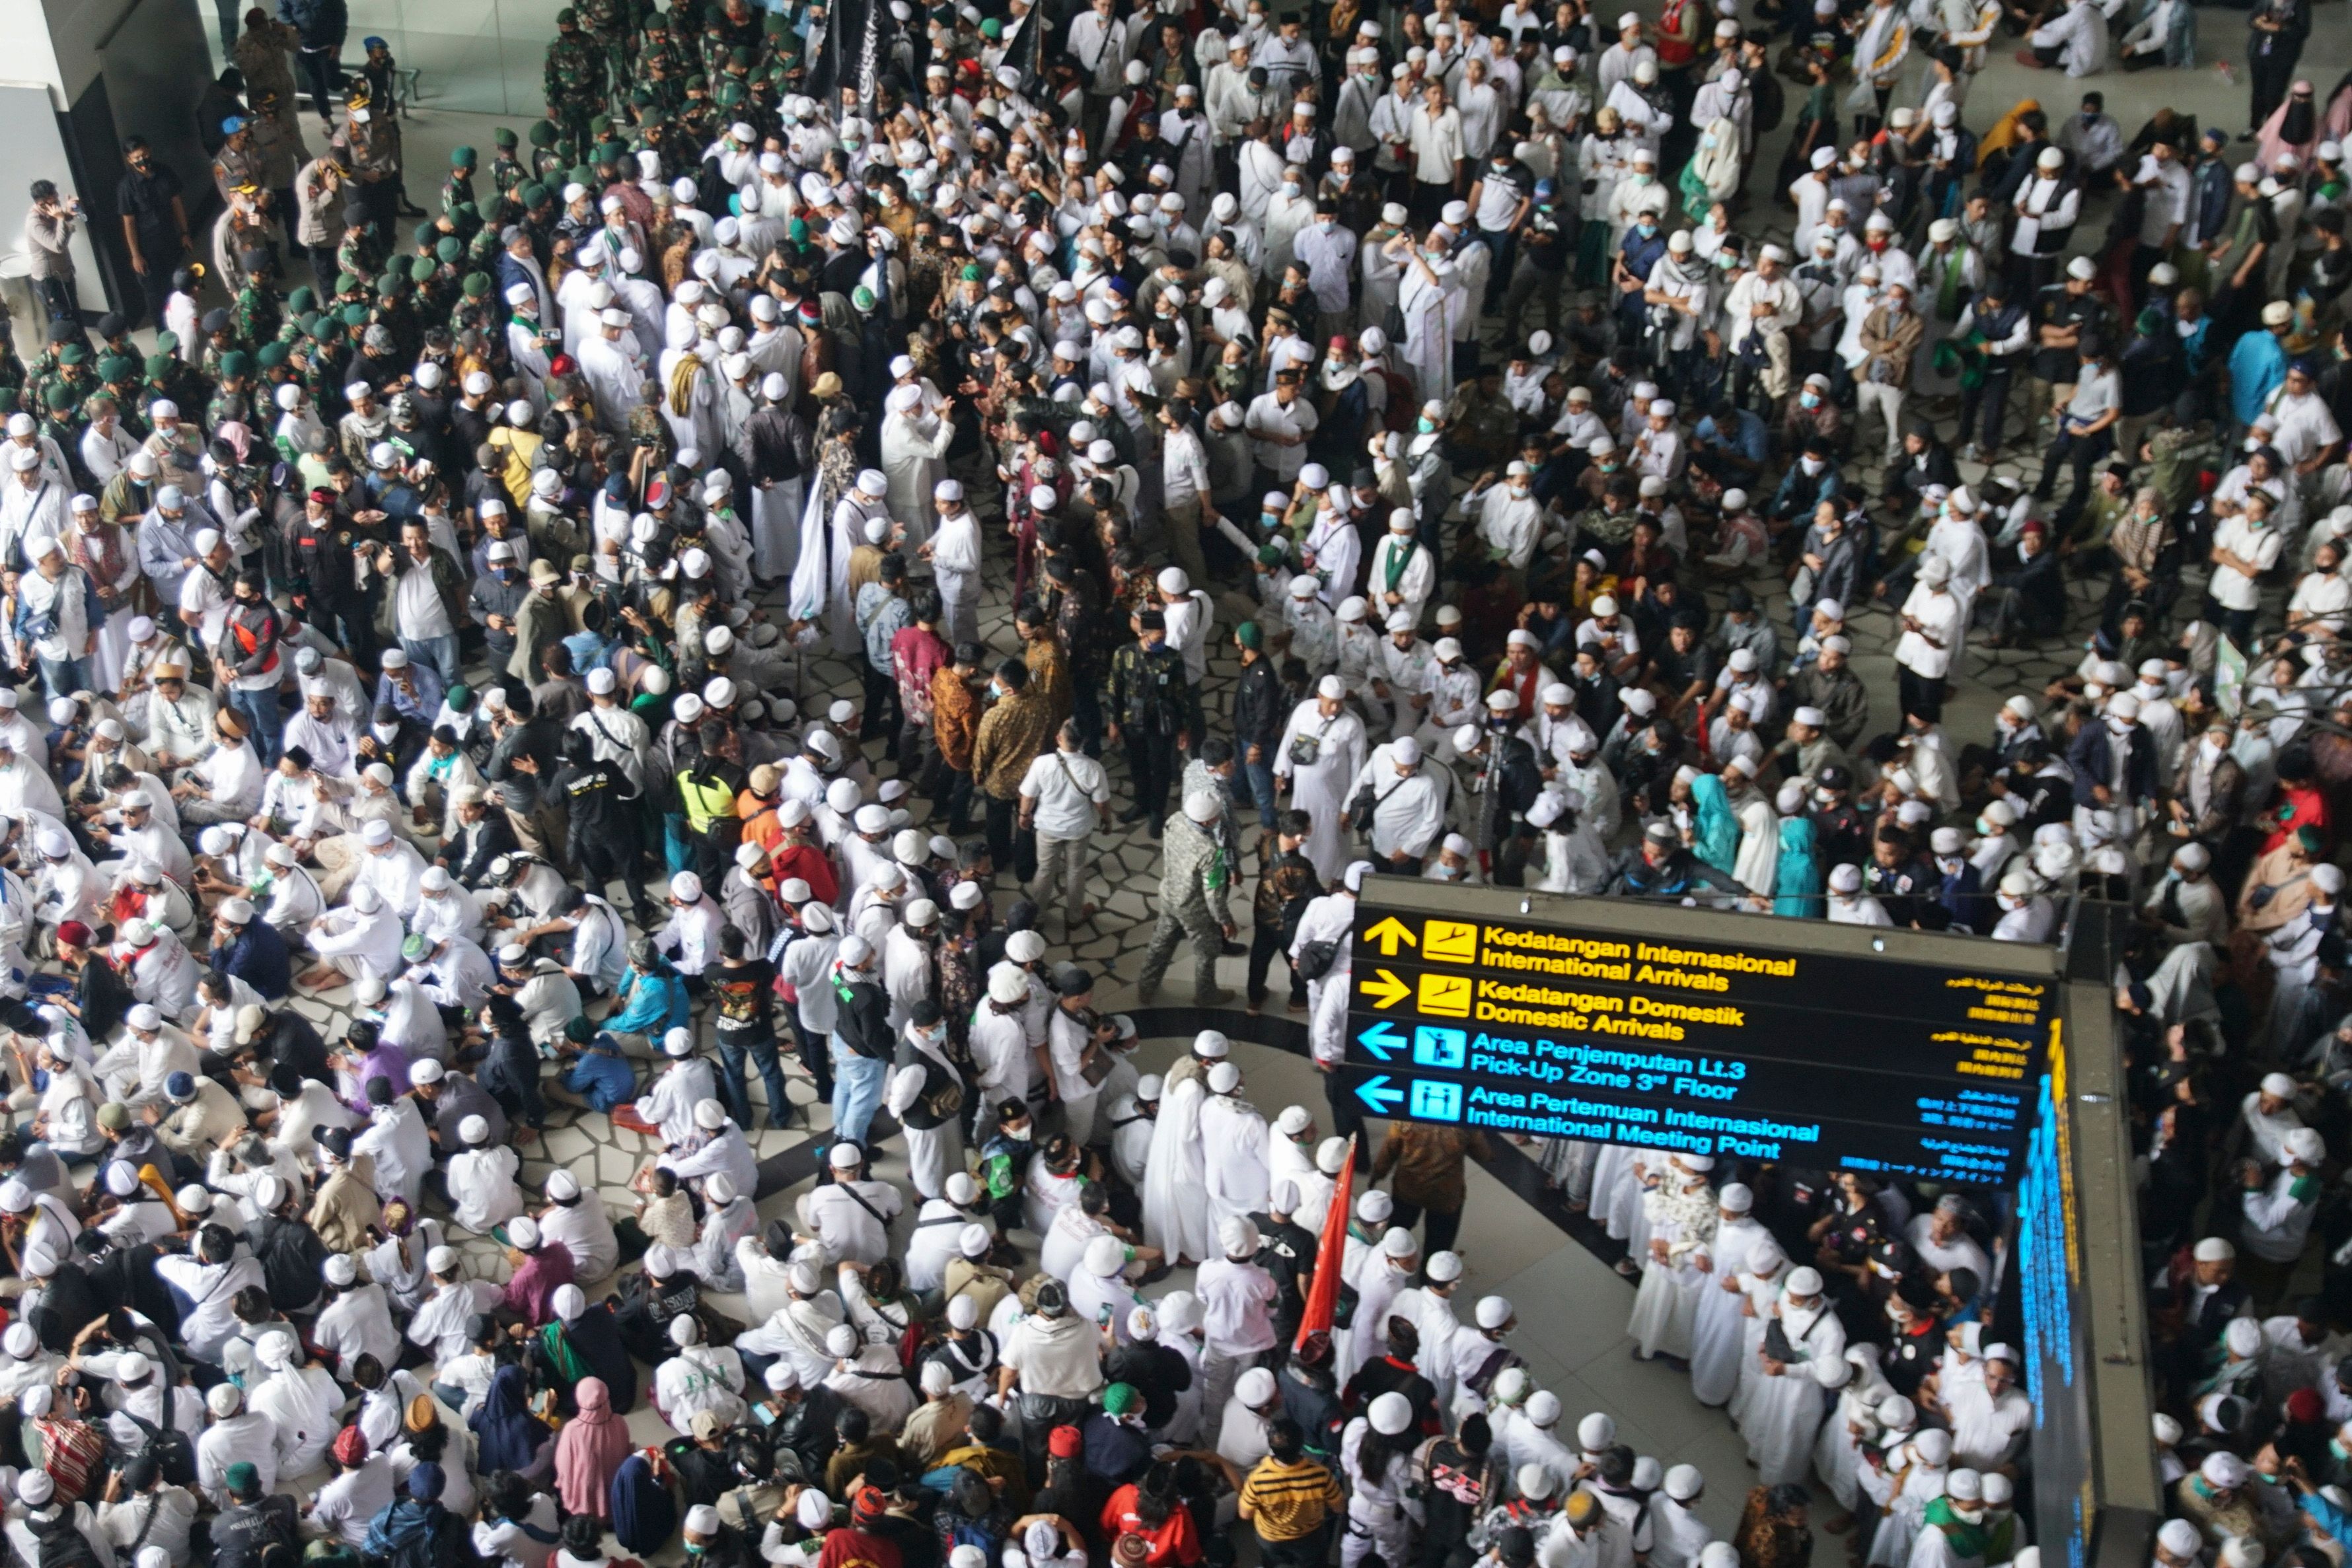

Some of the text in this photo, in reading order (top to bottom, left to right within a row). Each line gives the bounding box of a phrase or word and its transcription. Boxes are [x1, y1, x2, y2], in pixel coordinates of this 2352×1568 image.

[1481, 948, 1729, 991] International Arrivals
[1484, 926, 1796, 977] Kedatangan Internasional
[1476, 1001, 1685, 1041] Domestic Arrivals
[1478, 980, 1746, 1026] Kedatangan Domestik
[1471, 1032, 1746, 1079] Area Penjemputan Lt.3
[1471, 1053, 1738, 1100] Pick-Up Zone 3rd Floor
[1467, 1106, 1781, 1159] International Meeting Point
[1468, 1087, 1819, 1142] Area Pertemuan Internasional
